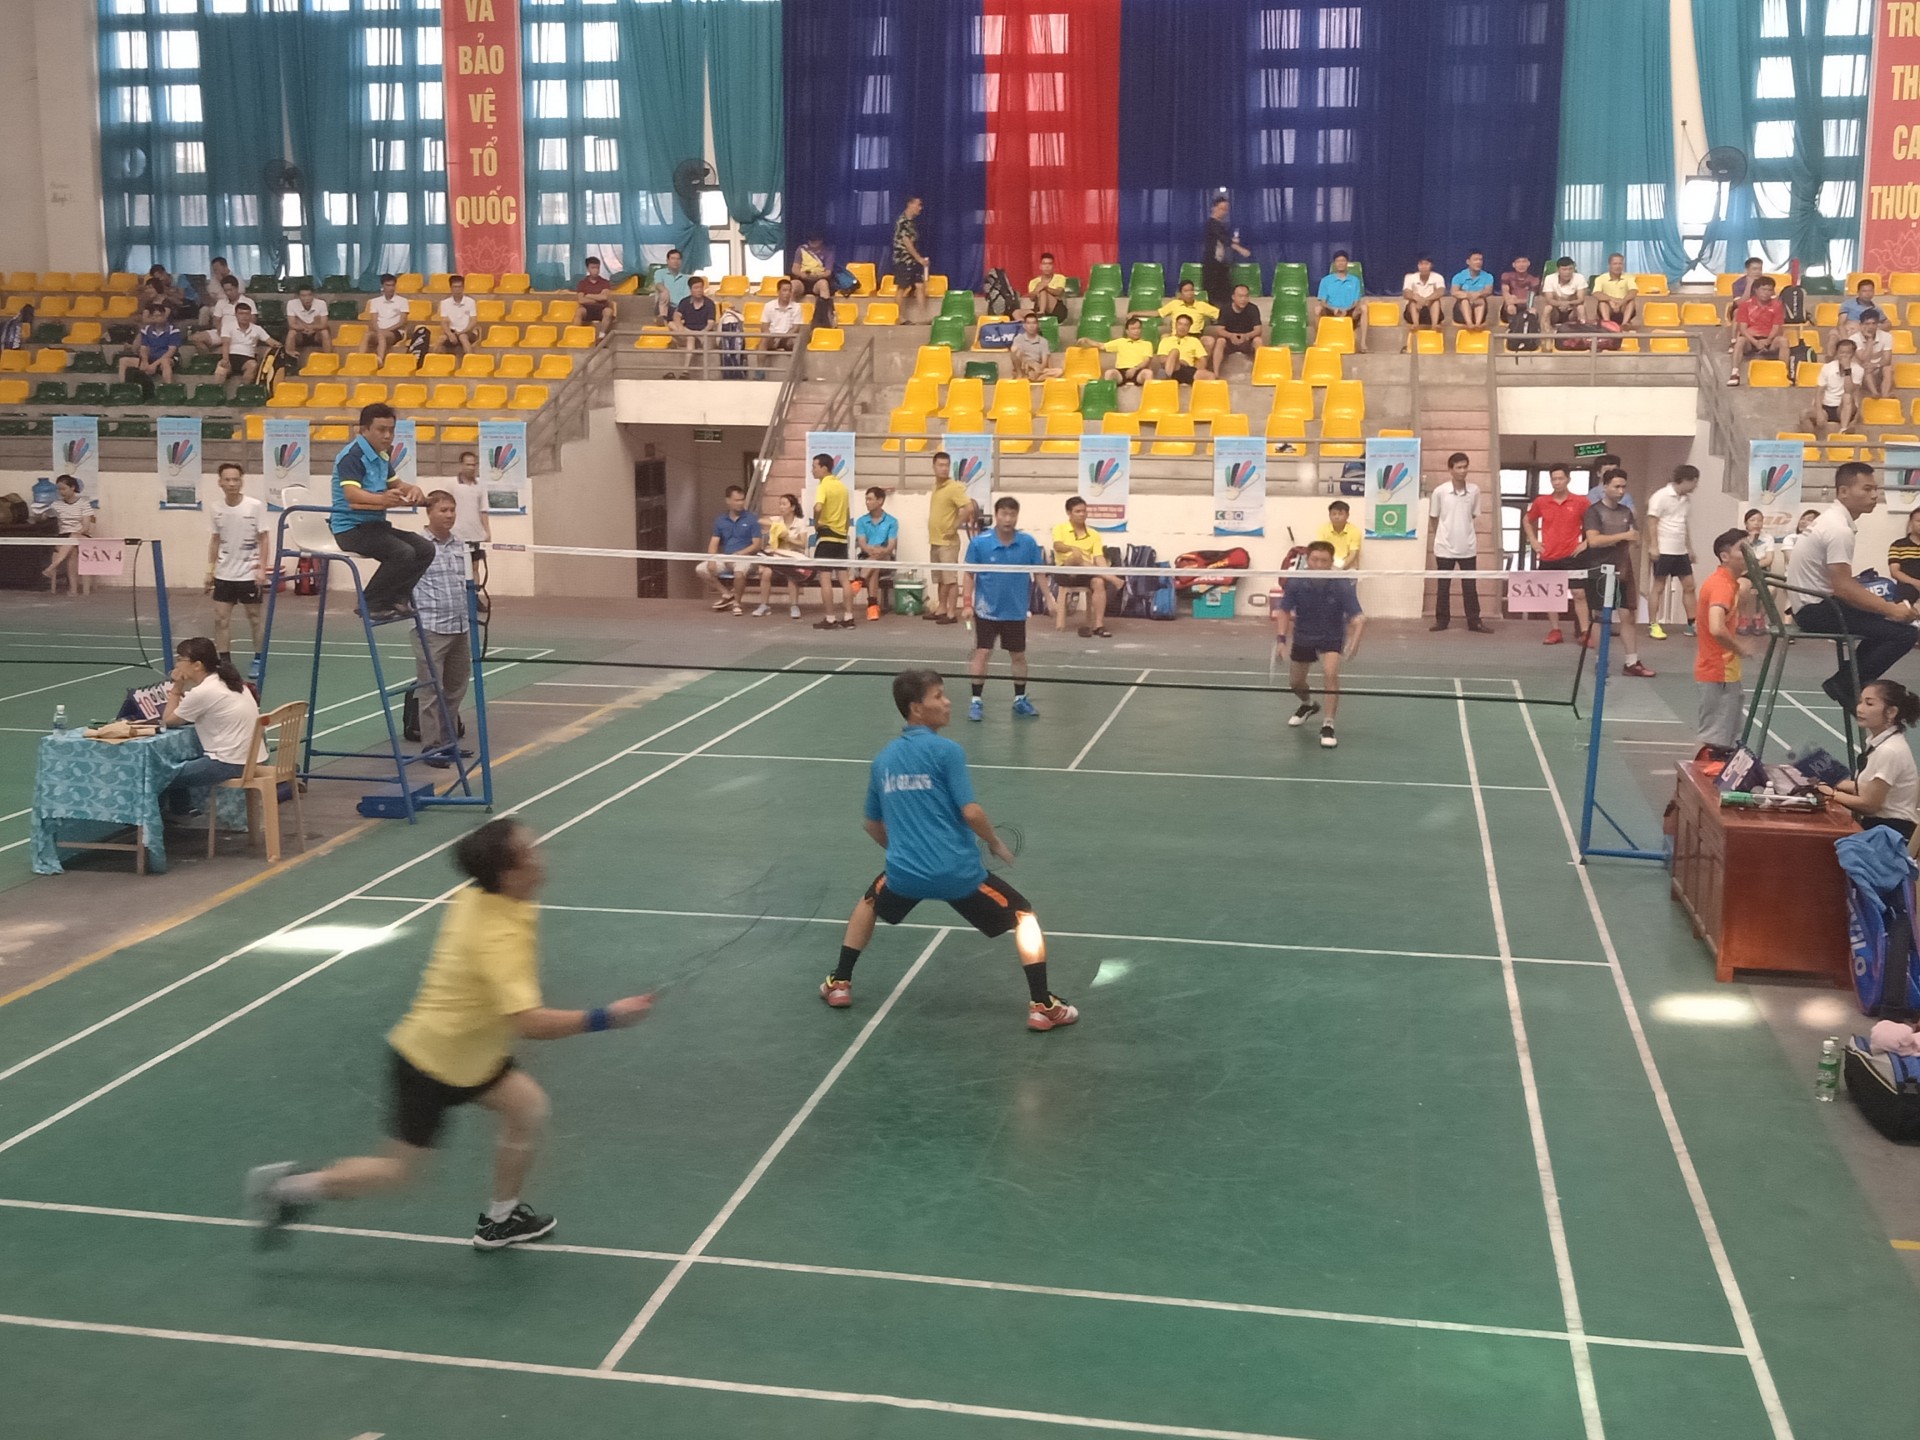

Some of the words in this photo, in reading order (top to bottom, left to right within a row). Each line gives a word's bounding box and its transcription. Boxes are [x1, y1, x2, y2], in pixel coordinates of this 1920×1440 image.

[458, 33, 505, 75] BẢO
[1891, 65, 1920, 100] TH
[468, 88, 497, 129] VỆ
[469, 136, 498, 176] TỔ
[1892, 125, 1920, 160] CA
[456, 185, 516, 228] QUỐC
[1870, 181, 1920, 228] THƯỢ
[81, 546, 110, 562] SÂN
[115, 550, 122, 562] 4
[1511, 579, 1549, 598] SÂN
[1555, 583, 1565, 598] 3
